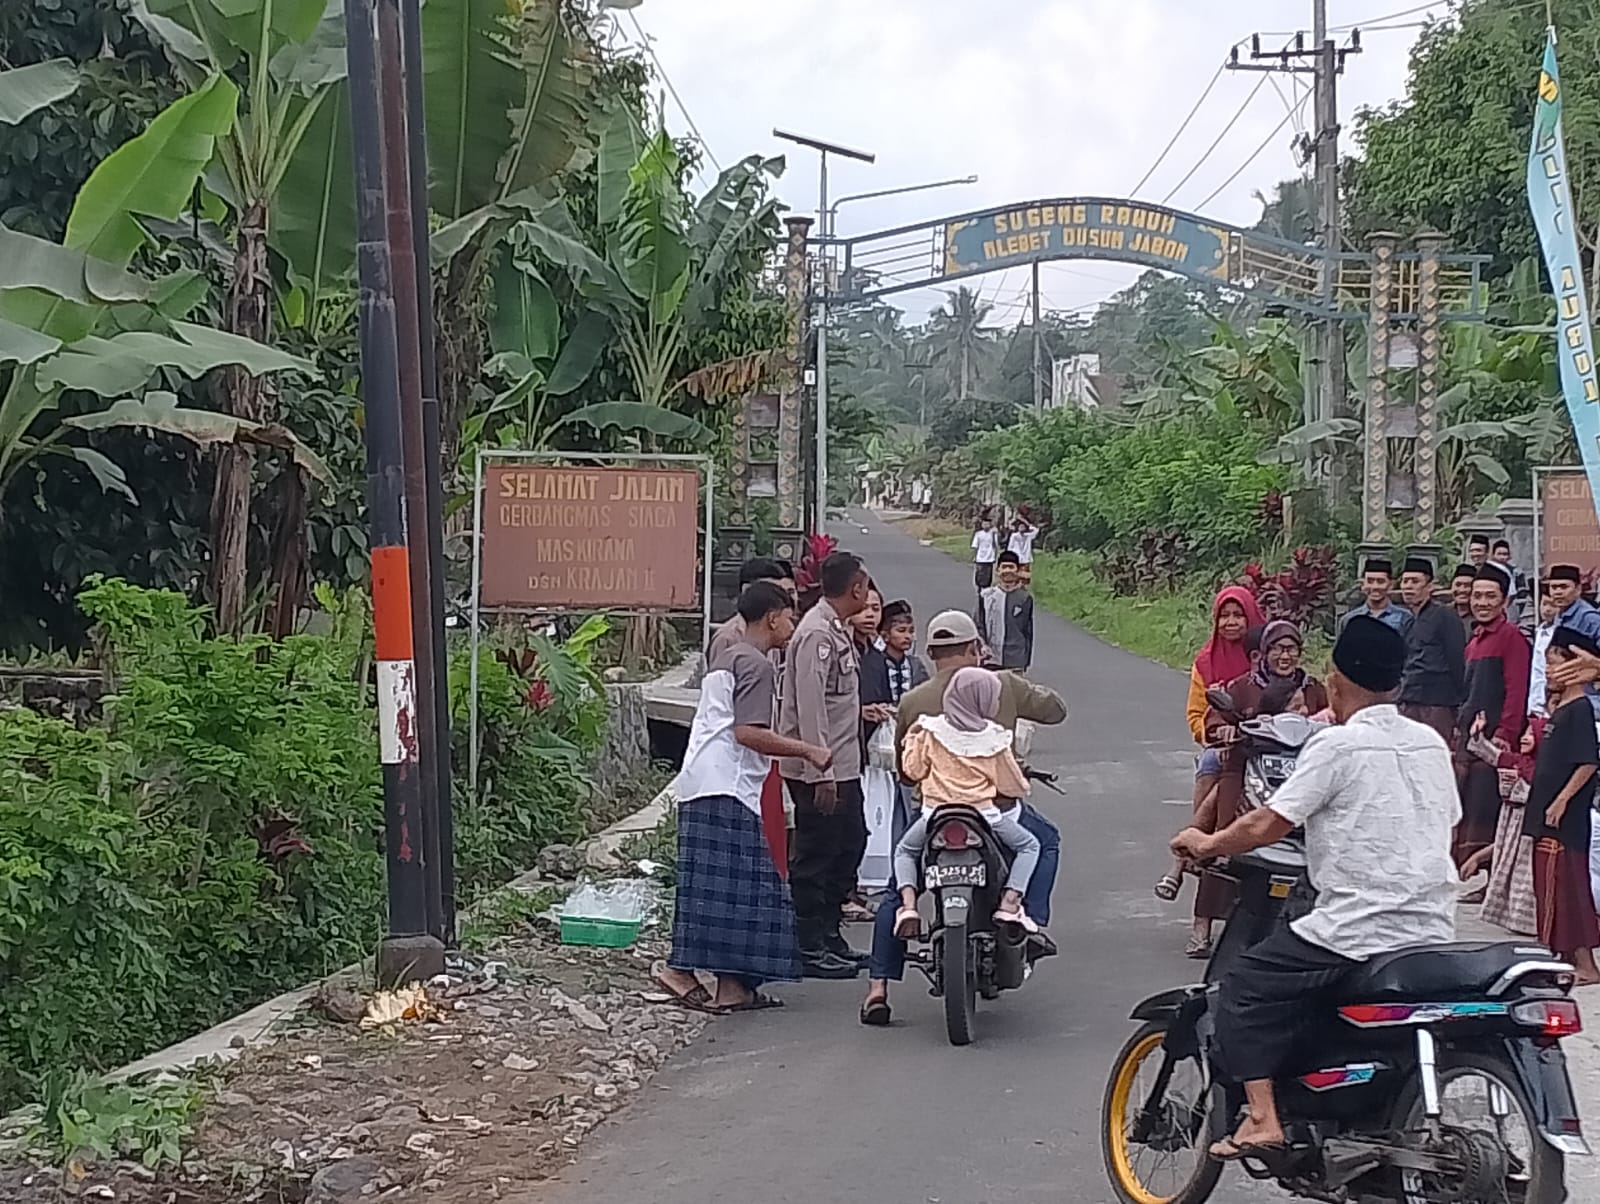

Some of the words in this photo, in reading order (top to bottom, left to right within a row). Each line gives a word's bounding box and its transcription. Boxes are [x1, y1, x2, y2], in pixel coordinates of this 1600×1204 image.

[994, 204, 1086, 234] SUGENG
[1063, 227, 1124, 249] DUSUN
[1128, 232, 1189, 262] JABON
[500, 472, 600, 500] SELAMAT
[609, 475, 685, 502] JALAN
[1547, 480, 1591, 500] SELA
[500, 503, 612, 527] GERBANGMAS
[628, 505, 677, 528] SIAGA
[567, 566, 638, 591] KRAJAN
